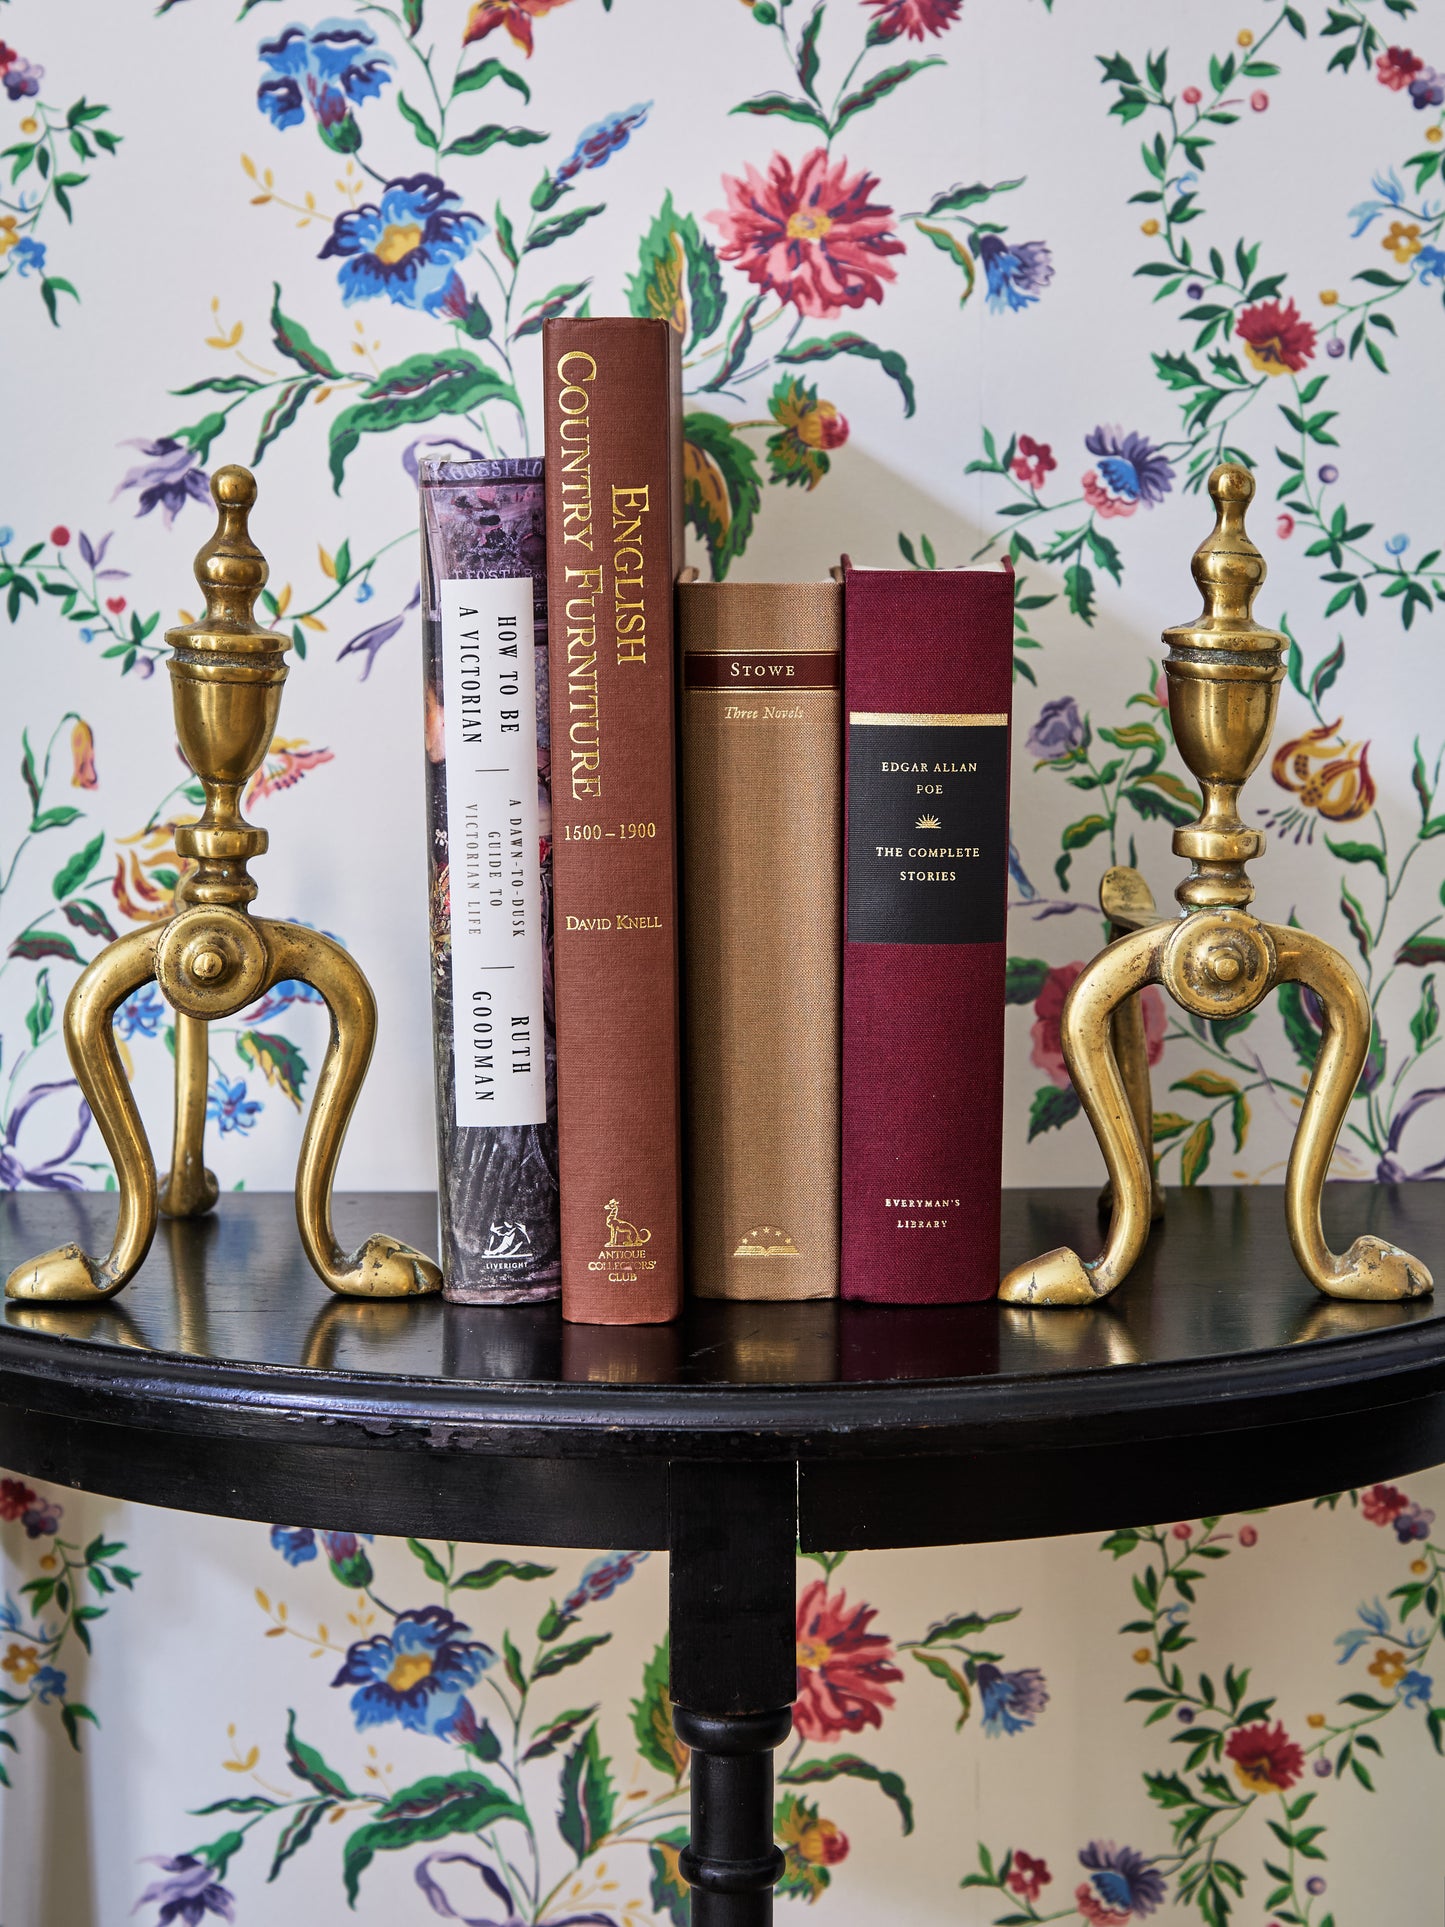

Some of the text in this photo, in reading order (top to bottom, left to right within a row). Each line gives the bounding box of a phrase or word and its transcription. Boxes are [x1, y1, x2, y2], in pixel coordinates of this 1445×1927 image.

[557, 351, 604, 800] COUNTRY FURNITURE
[611, 484, 650, 666] ENGLISH
[459, 606, 482, 743] A VICTORIAN
[498, 616, 520, 733] HOW TO BE
[730, 662, 796, 677] STOWE
[724, 706, 804, 719] Three Novels
[881, 761, 978, 773] EDGAR ALLAN
[916, 784, 944, 795] POE
[876, 847, 980, 858] THE COMPLETE
[465, 804, 481, 935] VICTORIAN LIFE
[487, 831, 503, 907] GUIDE TO
[509, 799, 526, 937] A DAWN-TO-DUSK
[900, 871, 956, 881] STORIES
[565, 914, 663, 931] DAVID KNELL
[472, 991, 495, 1101] GOODMAN
[511, 1016, 531, 1073] RUTH
[885, 1198, 960, 1208] EVERYMAN'S
[897, 1220, 947, 1229] LIBRARY
[598, 1250, 646, 1260] ANTIQUE
[486, 1261, 528, 1270] LIVERIGHT
[588, 1260, 657, 1271] COLLECORS'
[608, 1272, 638, 1282] CLUB
